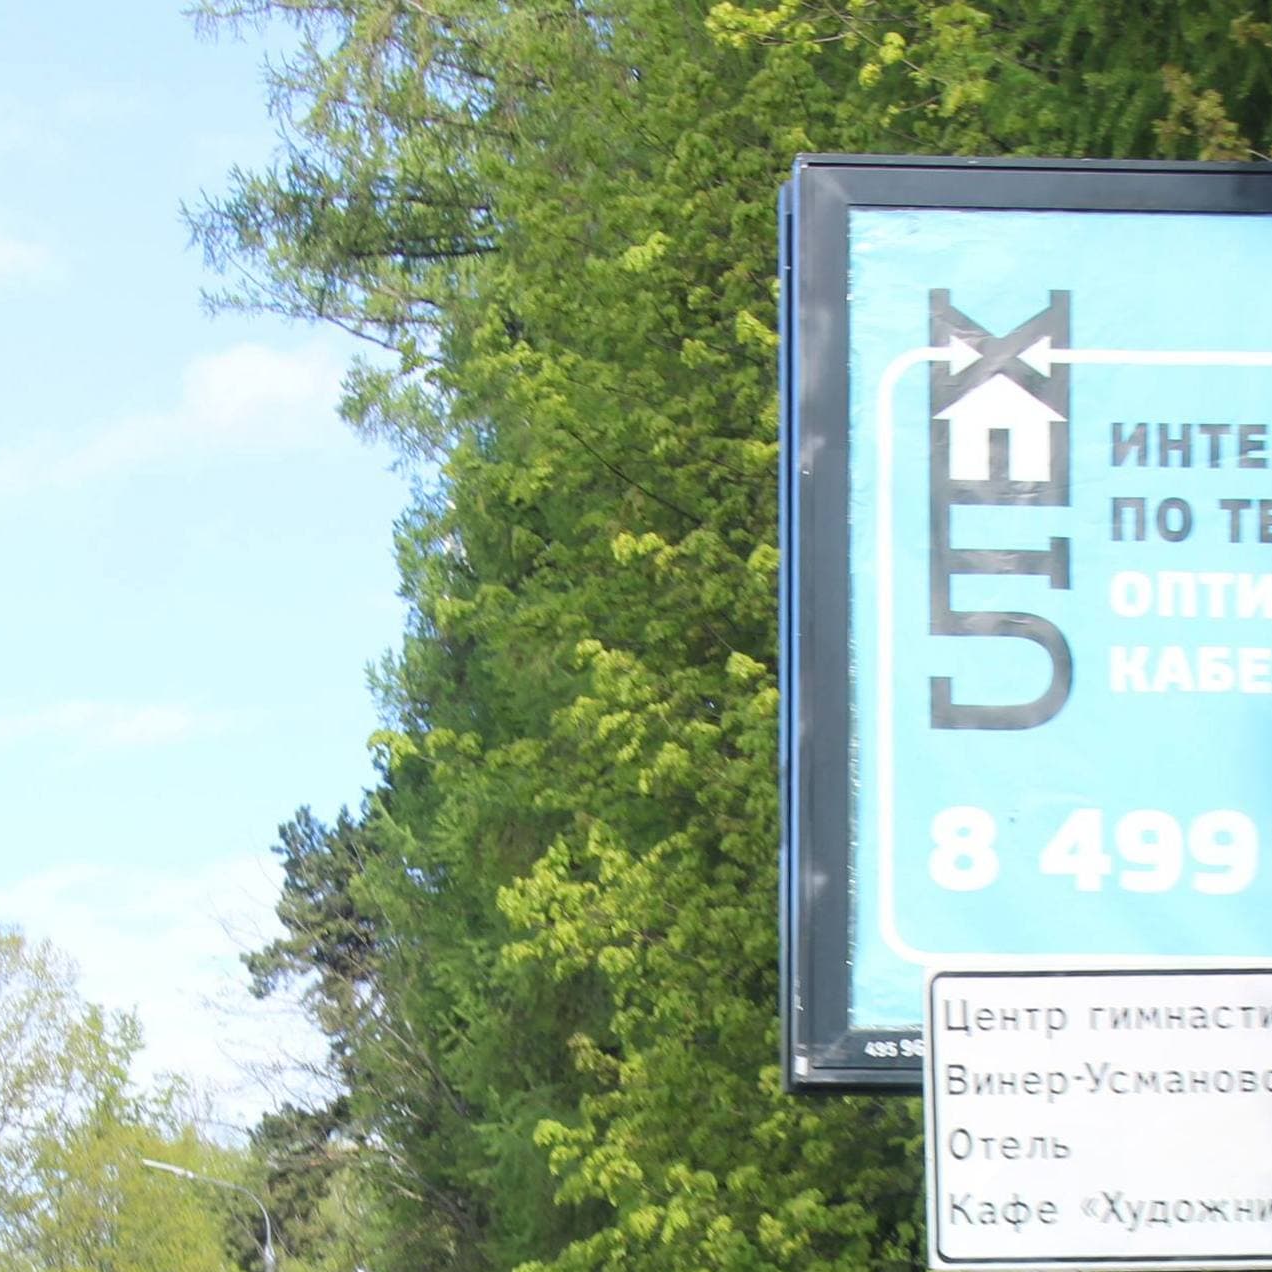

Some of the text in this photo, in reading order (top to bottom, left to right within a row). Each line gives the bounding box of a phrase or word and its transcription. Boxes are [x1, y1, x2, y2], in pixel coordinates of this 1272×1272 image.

[1111, 497, 1193, 542] ПО
[929, 805, 1000, 892] 8
[1040, 809, 1259, 893] 499
[944, 999, 1068, 1039] Центр
[948, 1128, 1071, 1160] Отель
[948, 1193, 1058, 1233] Кафе
